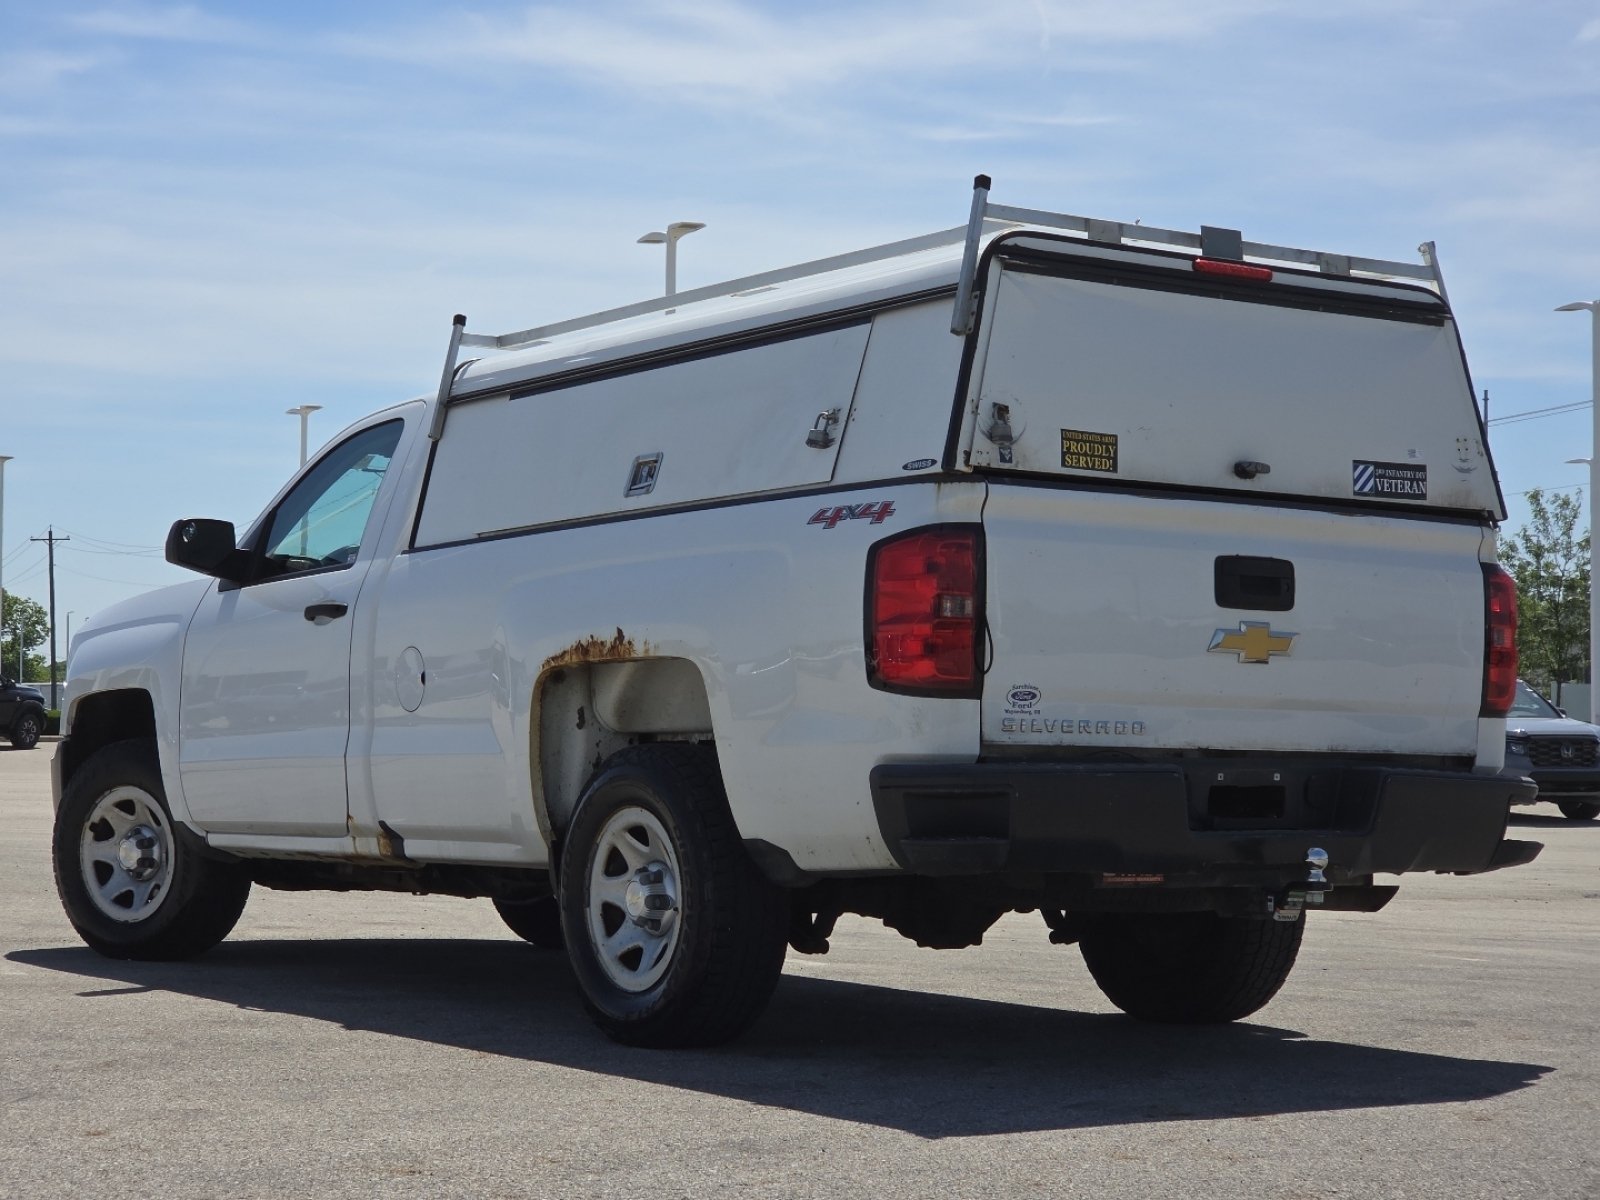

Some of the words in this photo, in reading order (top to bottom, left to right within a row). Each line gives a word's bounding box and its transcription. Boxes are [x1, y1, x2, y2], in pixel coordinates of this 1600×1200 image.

[1082, 433, 1101, 442] STATES
[1063, 440, 1116, 457] PROUDLY
[906, 459, 932, 470] SWISS
[1065, 454, 1113, 471] SERVED!
[1385, 469, 1414, 479] INFANTRY
[1375, 478, 1427, 494] VETERAN
[1012, 701, 1032, 709] Ford
[1001, 717, 1146, 735] SILVERADO
